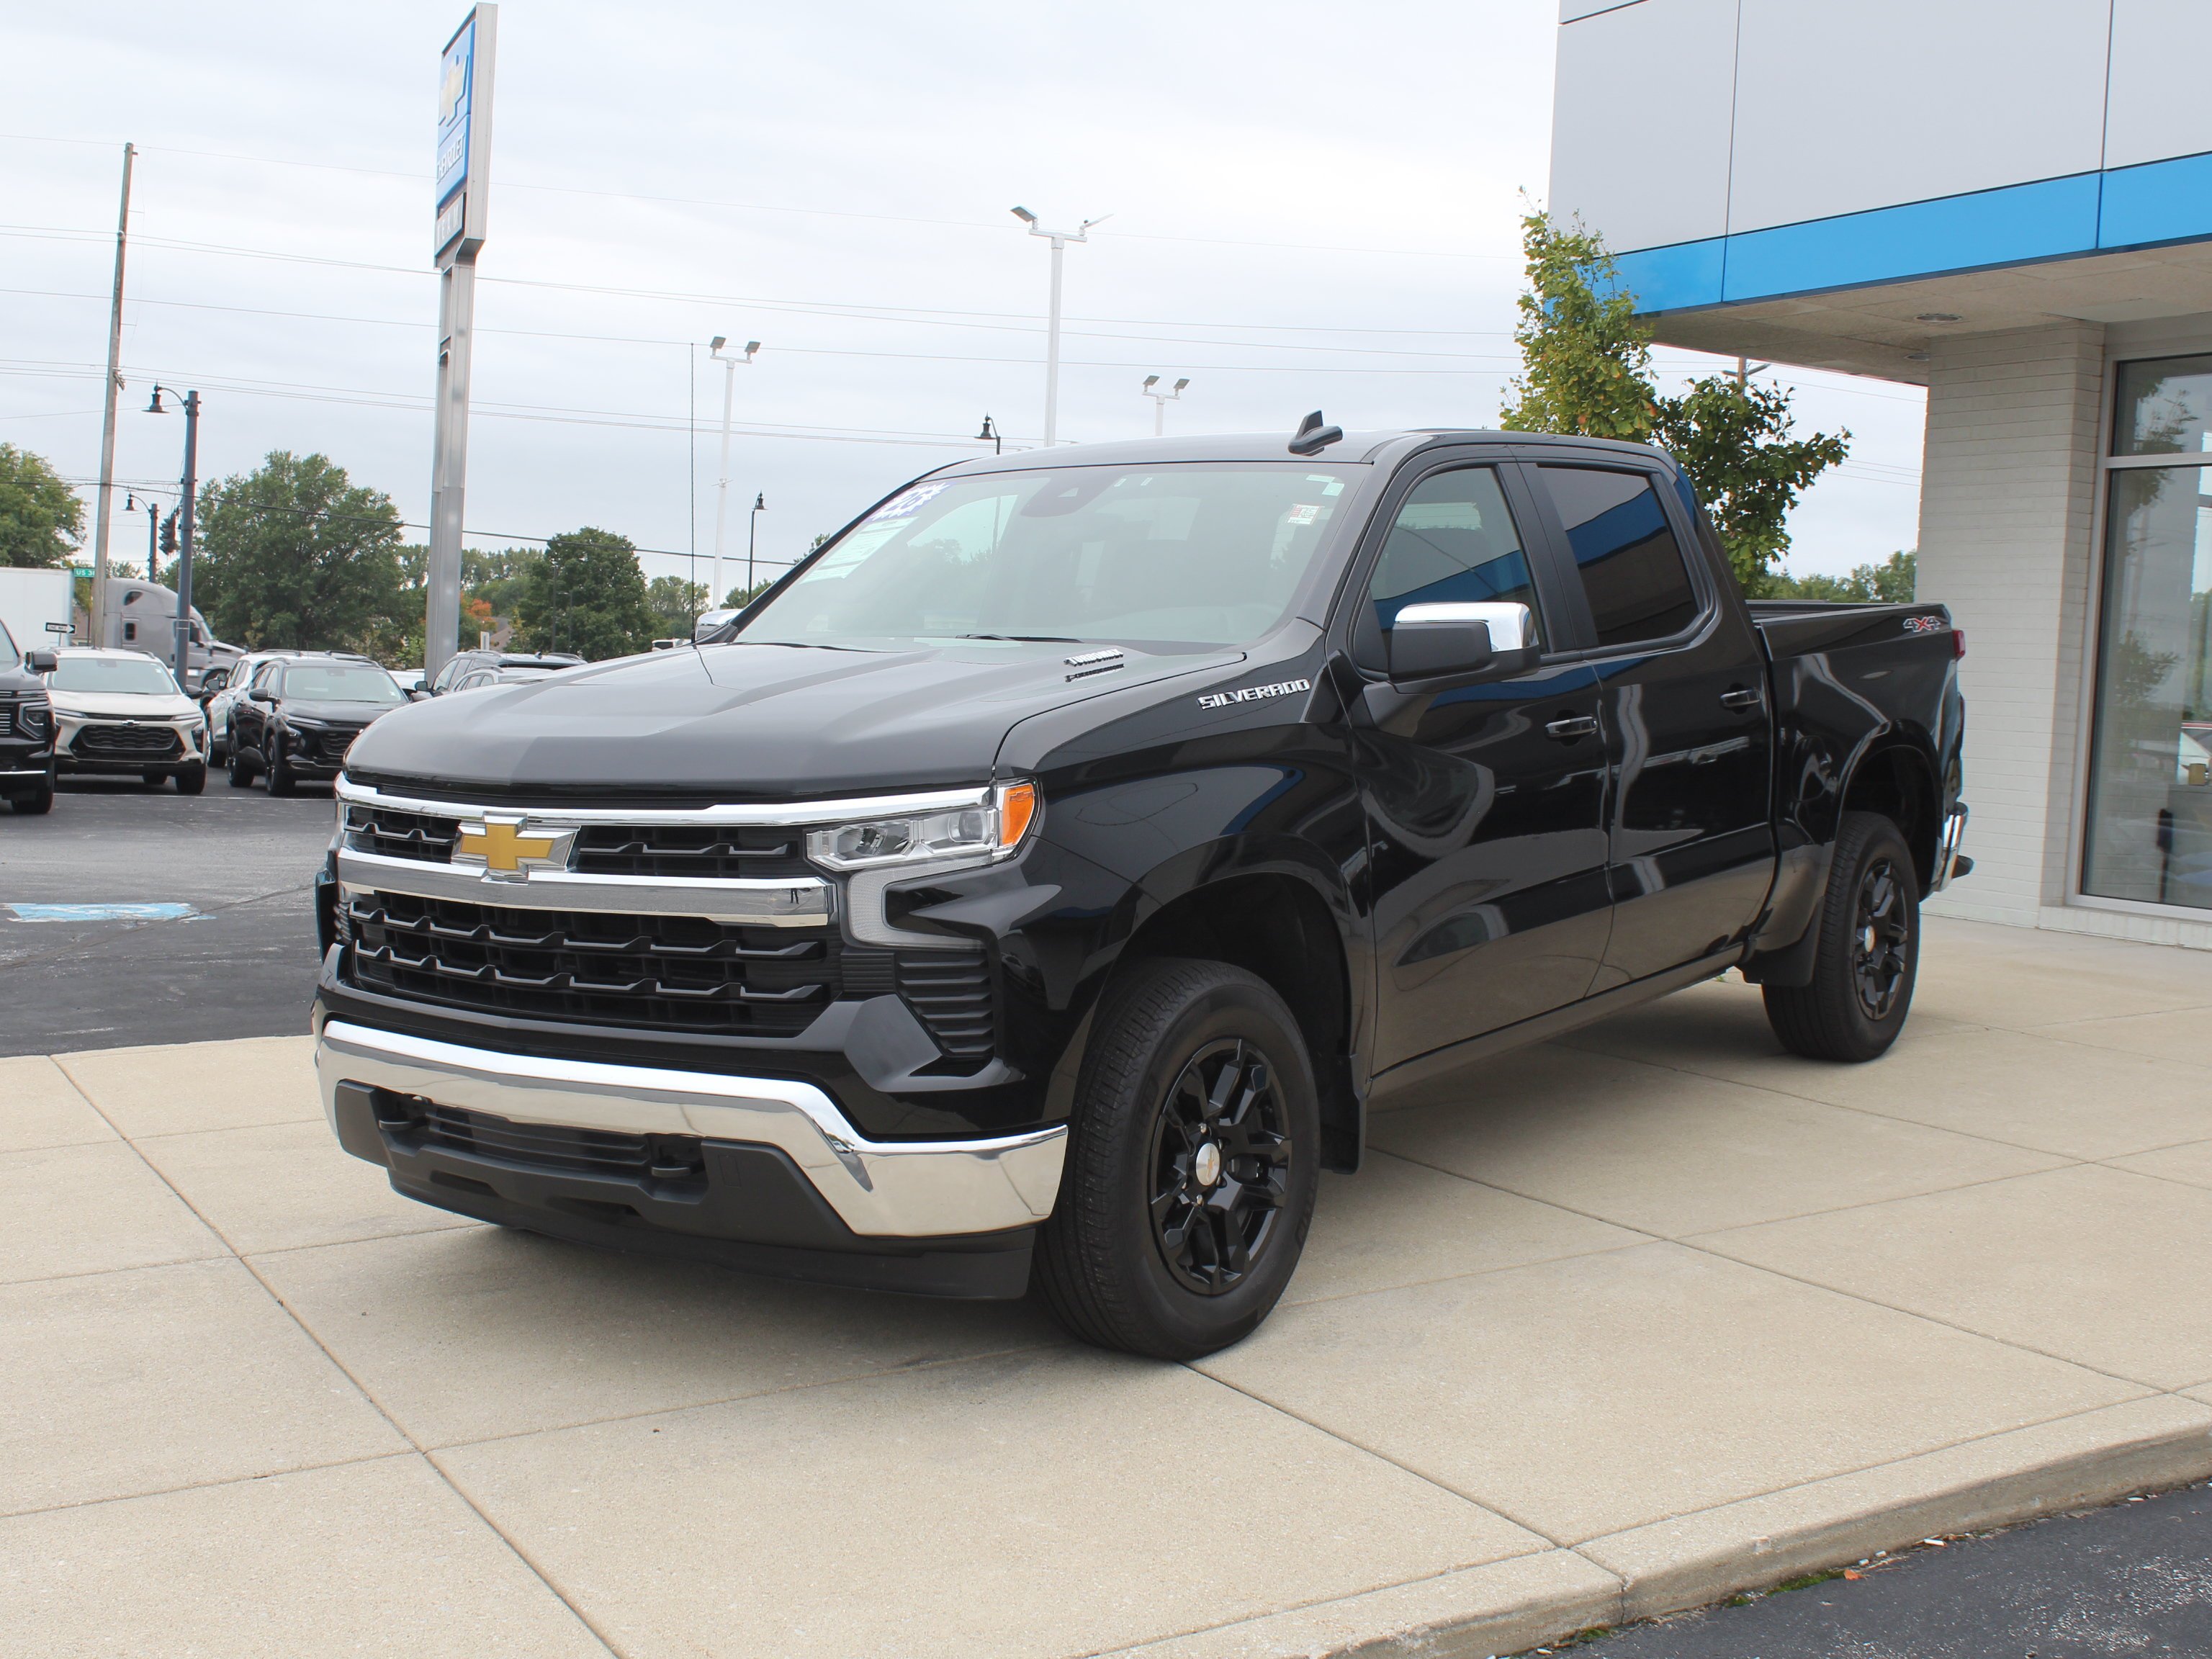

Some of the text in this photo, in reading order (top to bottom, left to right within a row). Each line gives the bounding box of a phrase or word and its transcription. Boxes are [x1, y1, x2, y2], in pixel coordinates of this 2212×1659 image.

[436, 204, 459, 246] TEAM
[1064, 649, 1123, 666] TURBOMAX
[1197, 679, 1310, 710] SILVERADO
